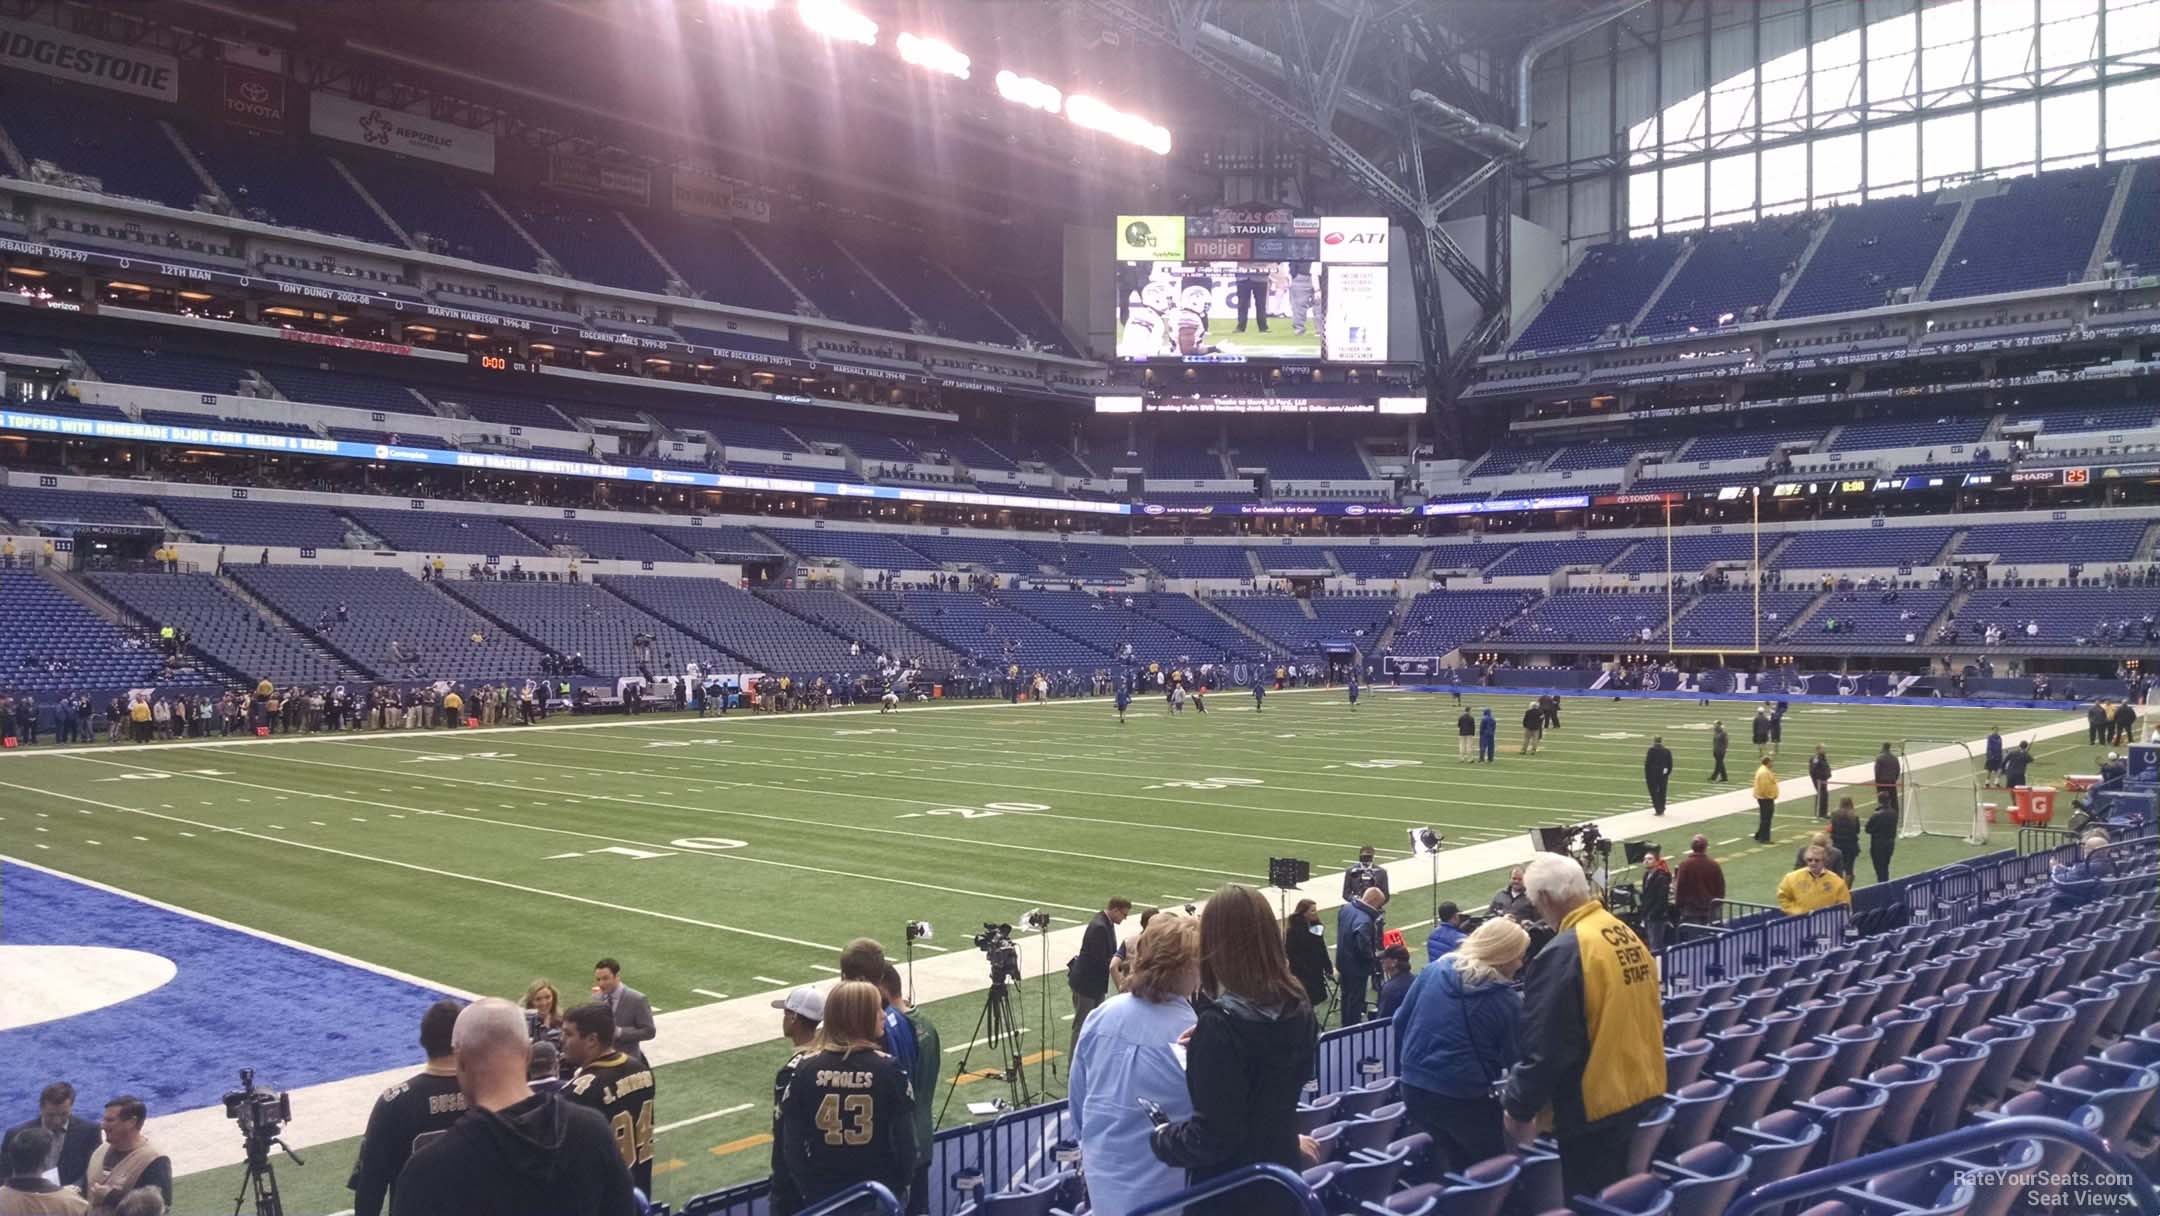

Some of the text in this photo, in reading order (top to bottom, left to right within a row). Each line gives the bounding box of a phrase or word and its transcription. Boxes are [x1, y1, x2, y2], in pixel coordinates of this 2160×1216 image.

[227, 99, 281, 120] TOYOTA
[396, 127, 453, 147] REPUBLIC
[1230, 225, 1277, 234] STADIUM
[1348, 232, 1386, 245] ATI
[48, 247, 89, 262] 1994-97
[1194, 239, 1244, 258] meijer
[161, 265, 212, 281] 12TH MAN
[278, 283, 370, 304] TONY DUNGY 2002-08
[47, 301, 80, 312] verizon
[426, 306, 459, 319] MARVIN
[460, 312, 500, 324] HARRISON
[615, 335, 639, 346] JAMES
[482, 356, 506, 370] 0:00
[8, 415, 58, 430] TOPPED
[61, 419, 92, 434] WITH
[96, 422, 169, 440] HOMEMADE
[171, 427, 208, 442] DIJON
[2011, 471, 2054, 483] SHARP
[2068, 470, 2085, 482] 25
[1629, 494, 1661, 503] TOYOTA
[925, 802, 1052, 819] 20
[2032, 796, 2046, 814] G
[587, 836, 749, 861] 10
[1601, 925, 1638, 946] CSC
[1616, 946, 1646, 966] EVENT
[1623, 964, 1649, 986] STAFF
[815, 1070, 874, 1089] SPROLES
[815, 1093, 874, 1145] 43
[610, 1099, 656, 1169] 94
